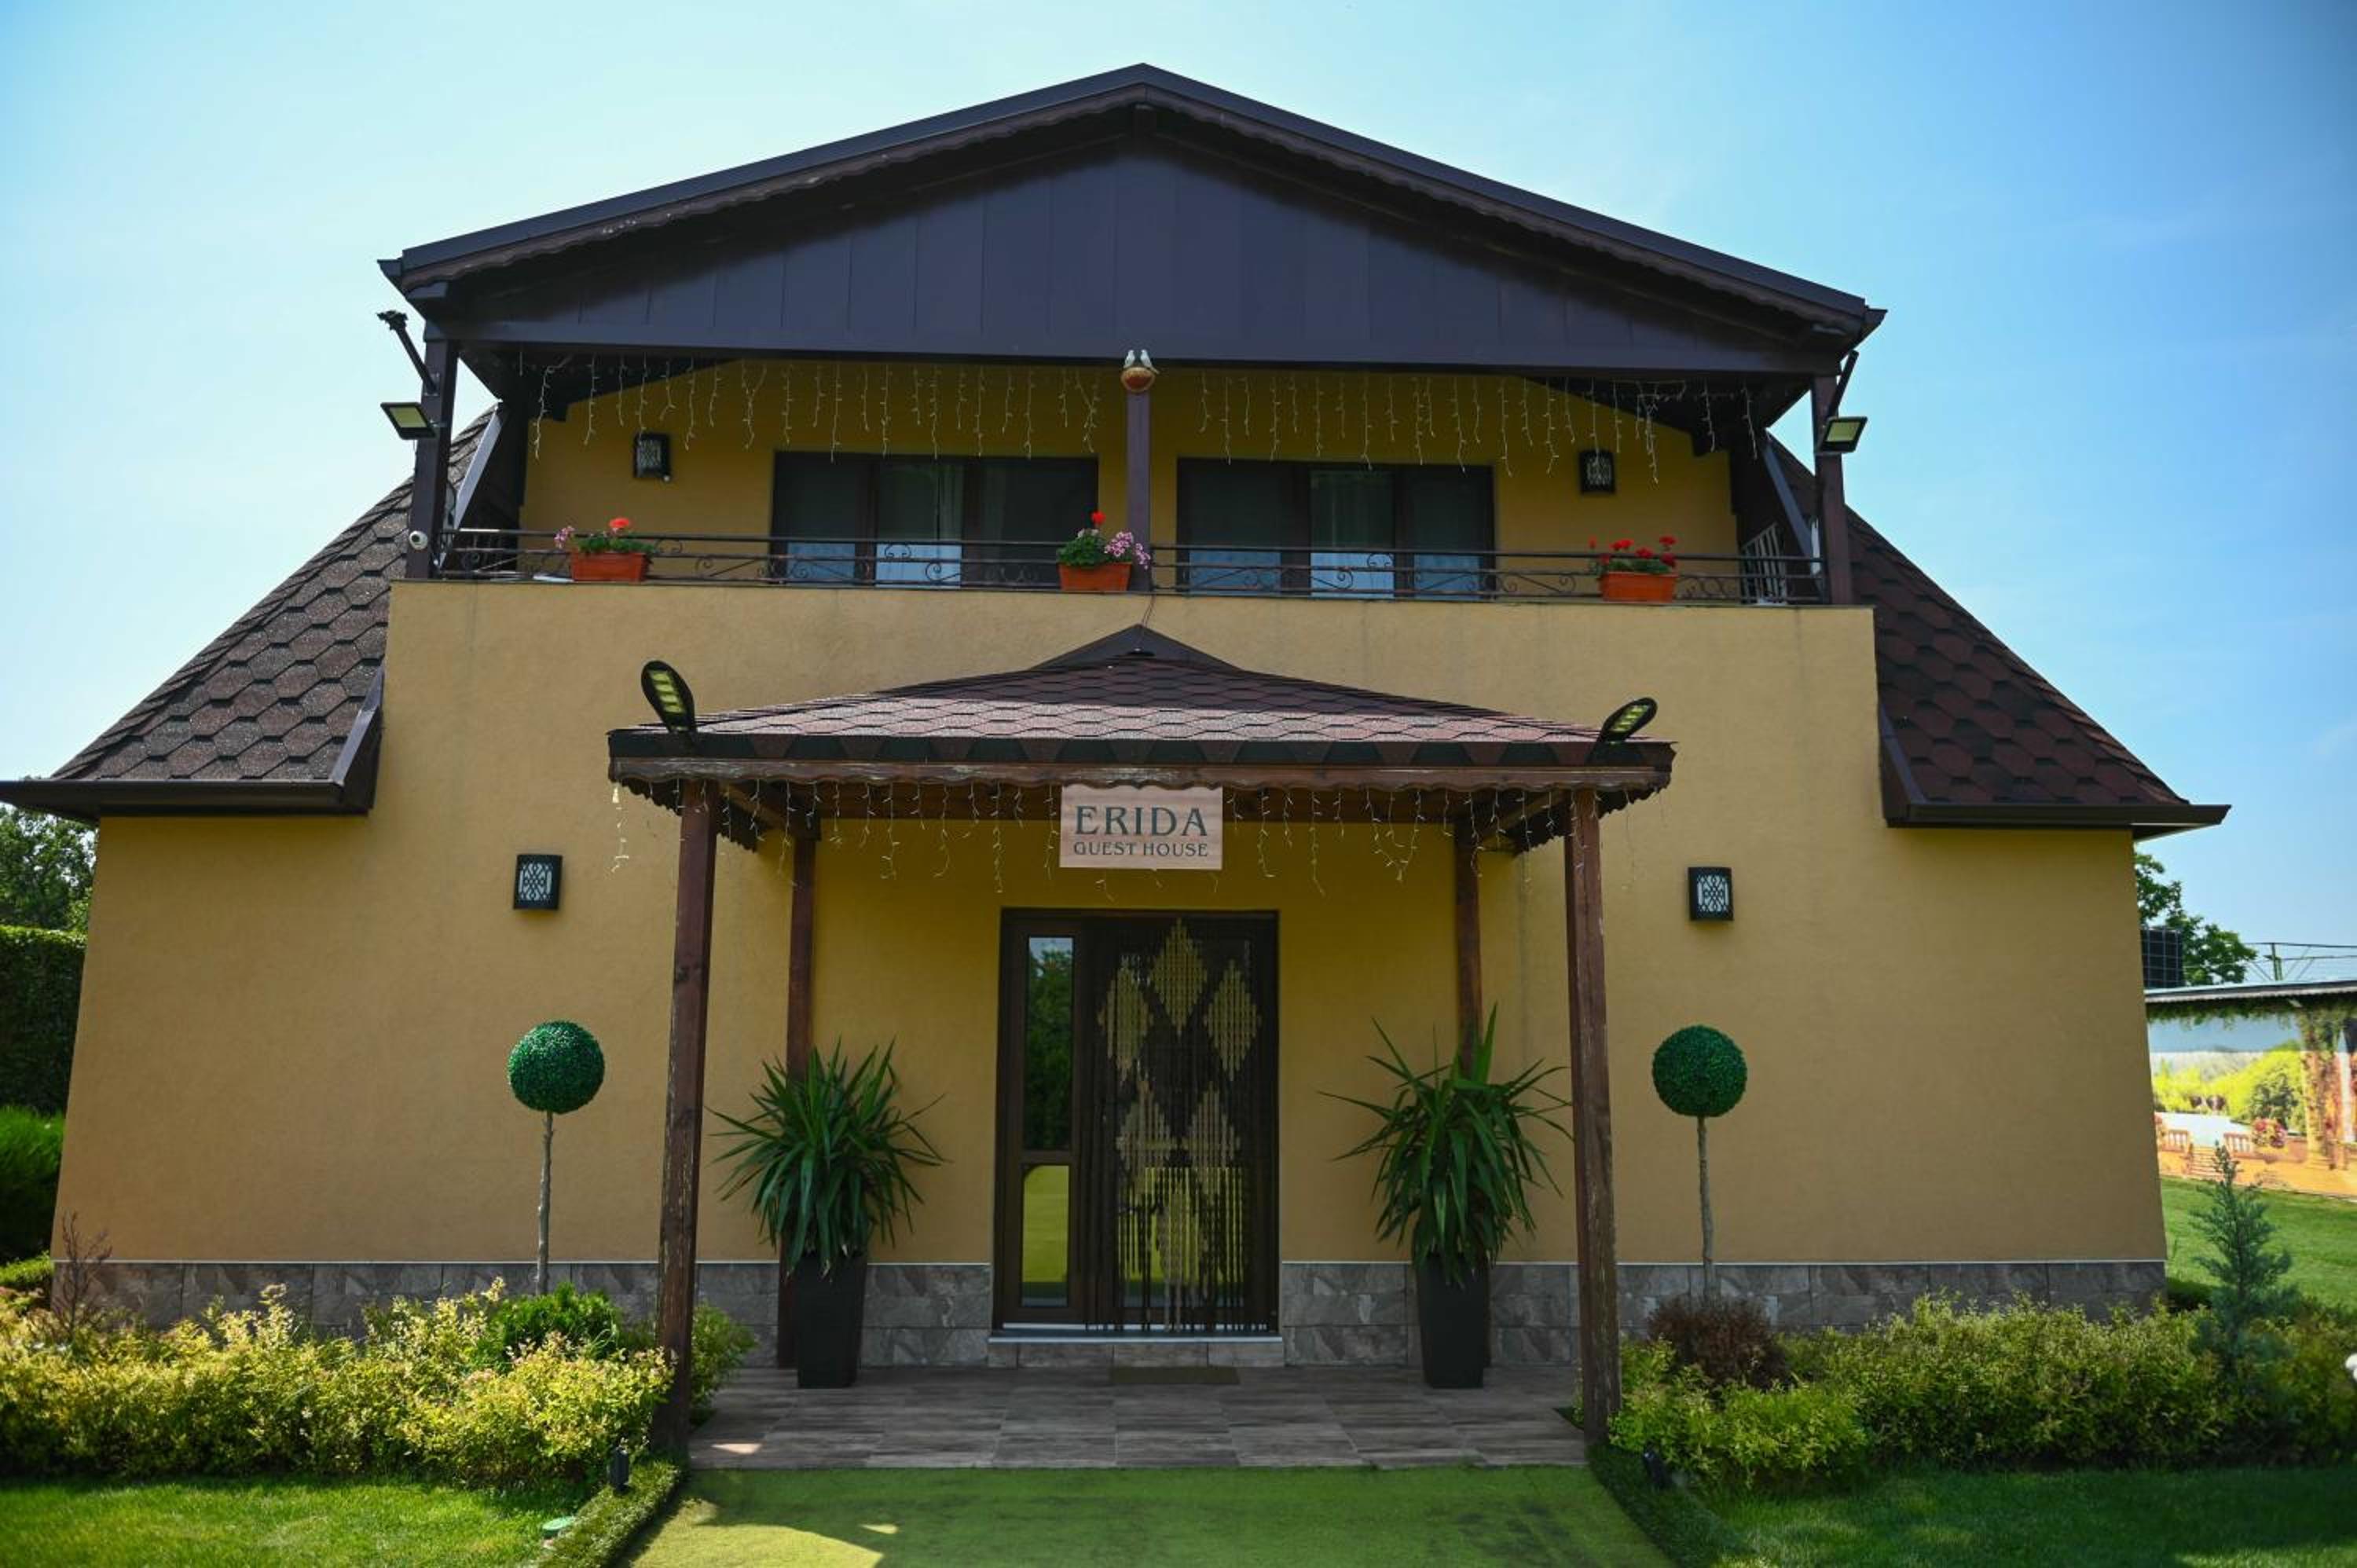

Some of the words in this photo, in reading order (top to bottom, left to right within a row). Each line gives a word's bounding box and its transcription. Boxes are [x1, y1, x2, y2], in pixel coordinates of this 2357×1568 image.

[1075, 805, 1208, 837] ERIDA
[1073, 841, 1137, 855] GUEST
[1143, 842, 1208, 857] HOUSE
